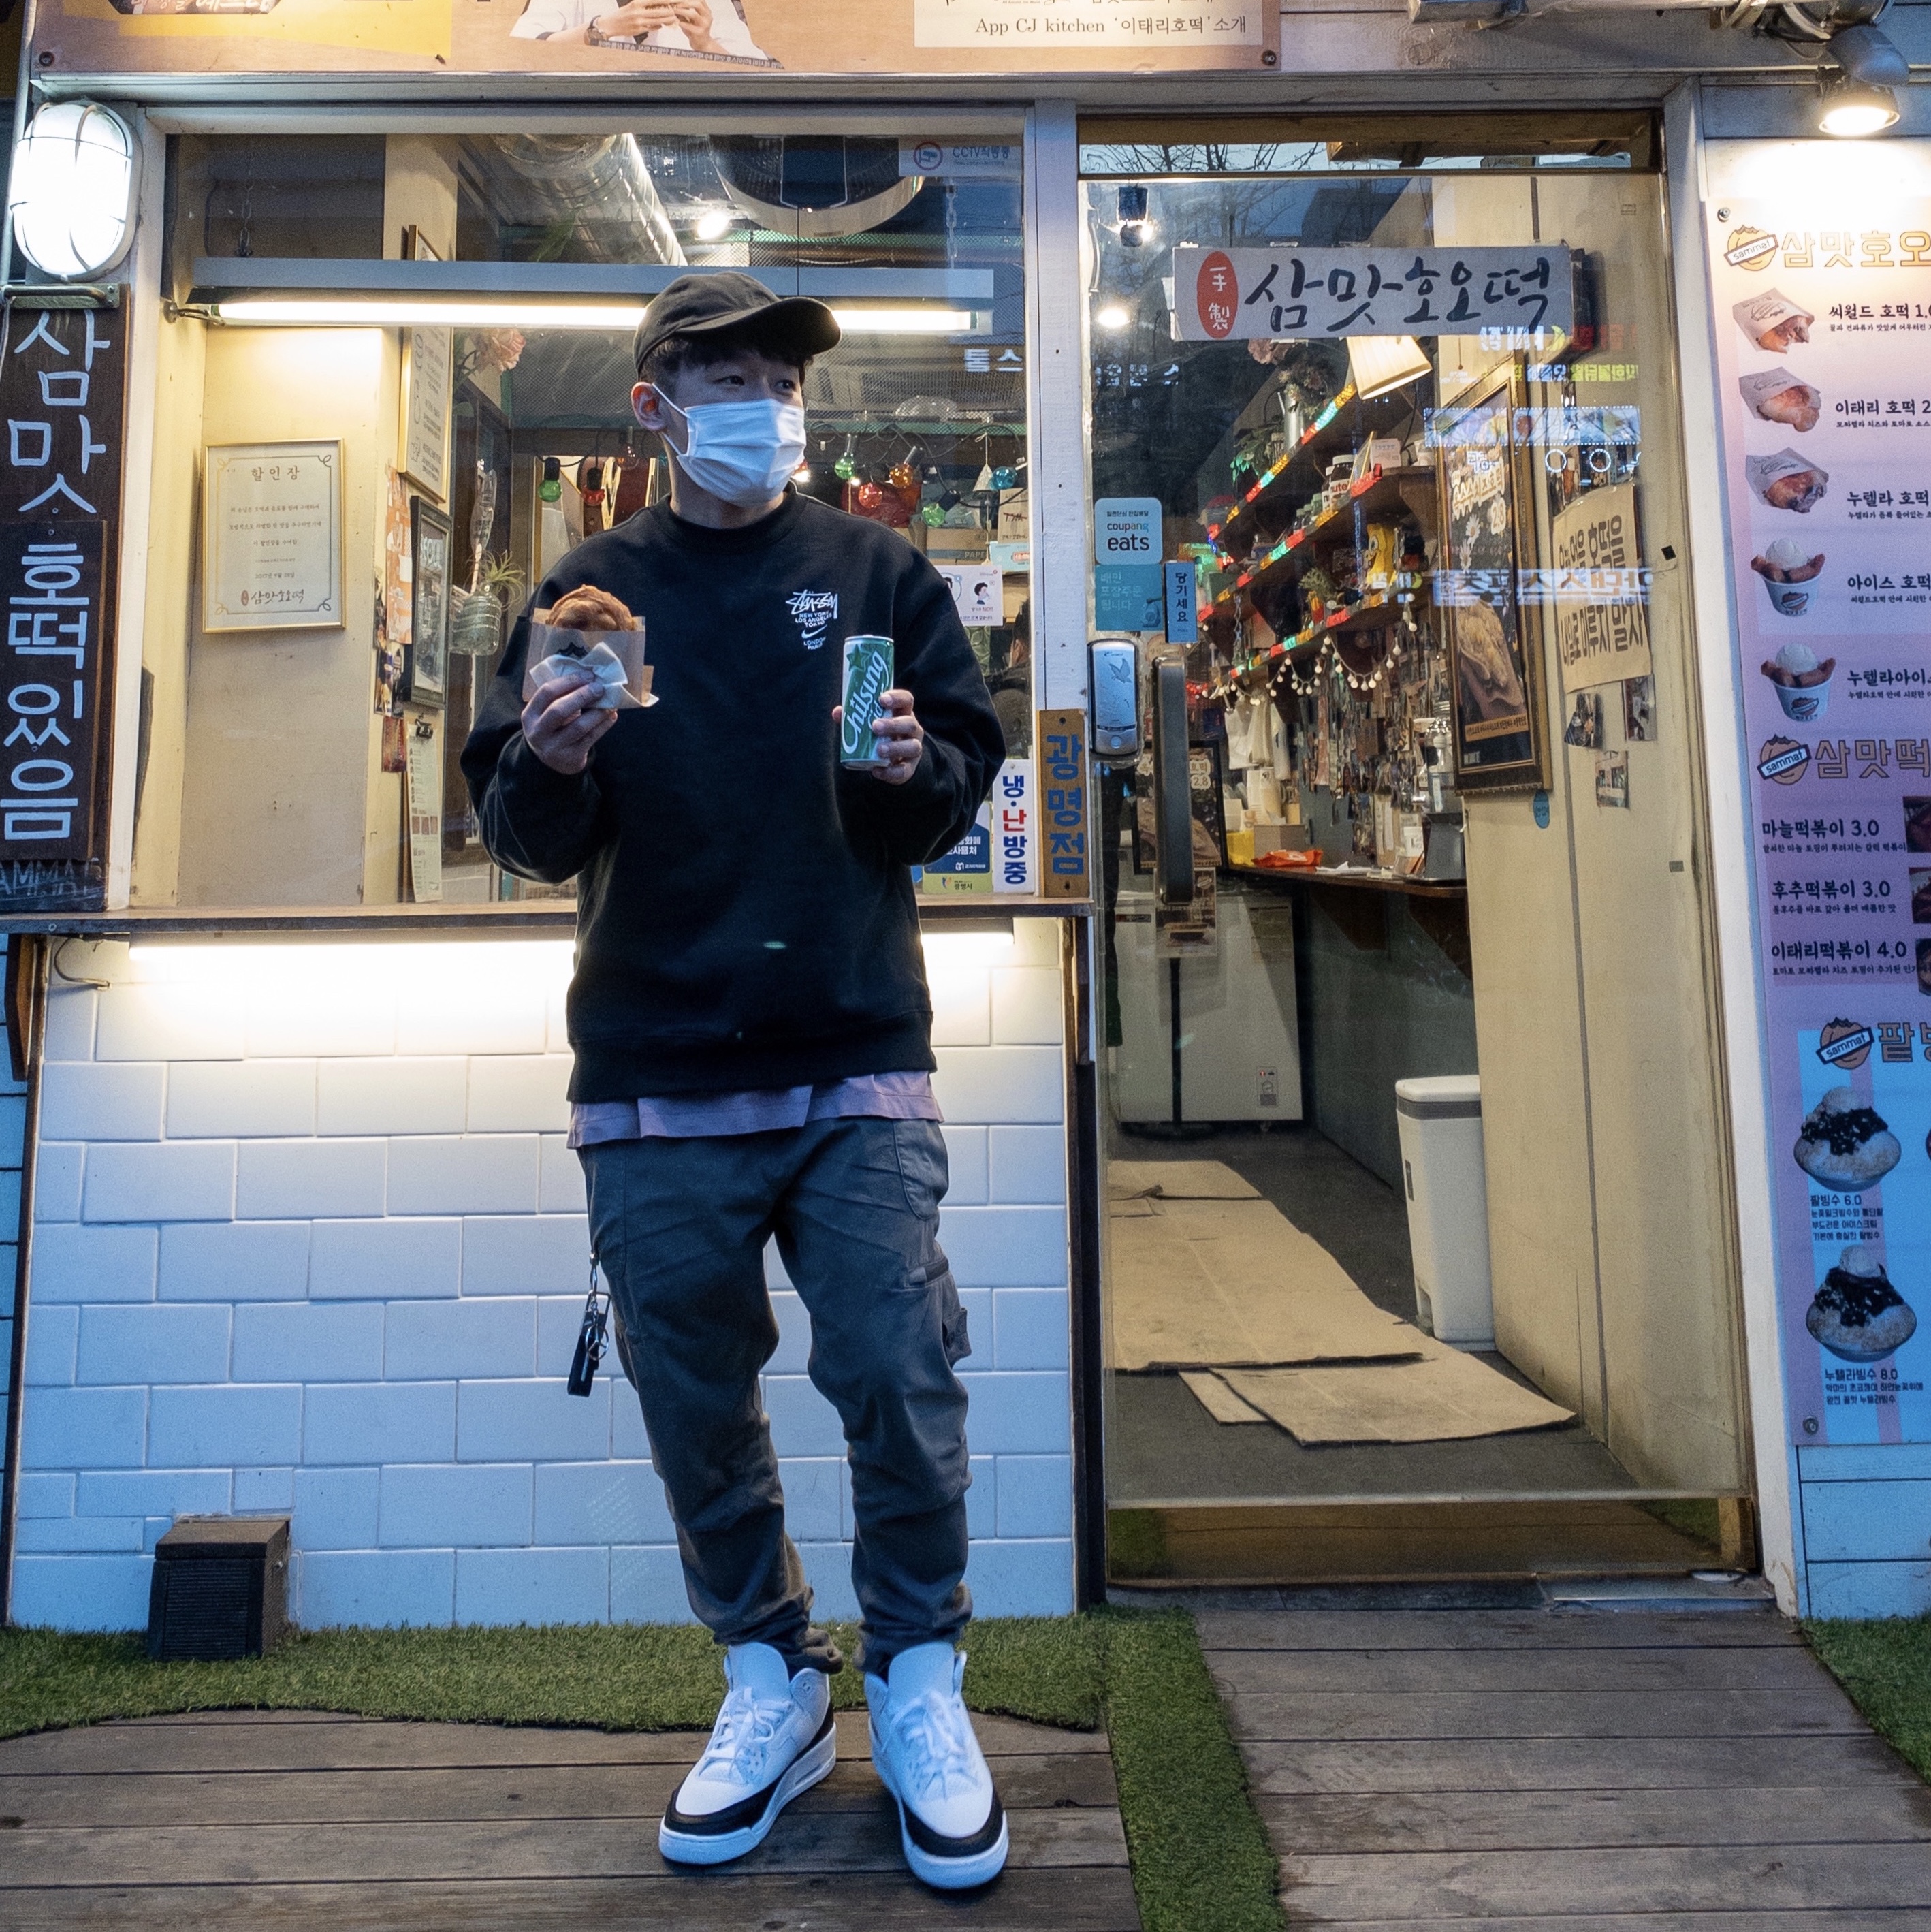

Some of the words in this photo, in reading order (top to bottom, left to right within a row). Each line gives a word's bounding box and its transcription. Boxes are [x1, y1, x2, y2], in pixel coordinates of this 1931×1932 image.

[976, 18, 1008, 35] App
[1015, 18, 1037, 33] CJ
[1044, 18, 1105, 33] kitchen
[1732, 239, 1771, 261] sammat
[1244, 256, 1551, 332] 삼맛호오떡
[1829, 303, 1874, 320] 씨월드
[1880, 303, 1909, 319] 호떡
[1836, 399, 1879, 415] 이태리
[1885, 399, 1915, 415] 호떡
[1847, 490, 1894, 507] 누텔라
[1898, 489, 1929, 507] 호떡
[1106, 522, 1149, 533] coupang
[1107, 533, 1150, 552] eats
[1100, 585, 1143, 598] 포장주문
[1847, 573, 1896, 591] 아이스
[1900, 573, 1931, 591] 호떡
[1175, 572, 1189, 623] 당기세요
[808, 612, 832, 623] ANGELES
[1847, 668, 1931, 687] 누텔라아이
[842, 650, 890, 754] Chilsung
[1766, 750, 1804, 774] sammat
[1193, 776, 1209, 787] 2.8
[1044, 733, 1085, 877] 광명점
[1762, 818, 1845, 839] 마늘떡볶이
[1851, 819, 1879, 837] 3.0
[1772, 879, 1855, 900] 후추떡볶이
[1862, 880, 1891, 898] 3.0
[1771, 940, 1870, 961] 이태리떡볶이
[1877, 940, 1907, 959] 4.0
[1825, 1031, 1867, 1058] sammat
[1844, 1194, 1862, 1206] 6.0
[1880, 1368, 1898, 1380] 8.0
